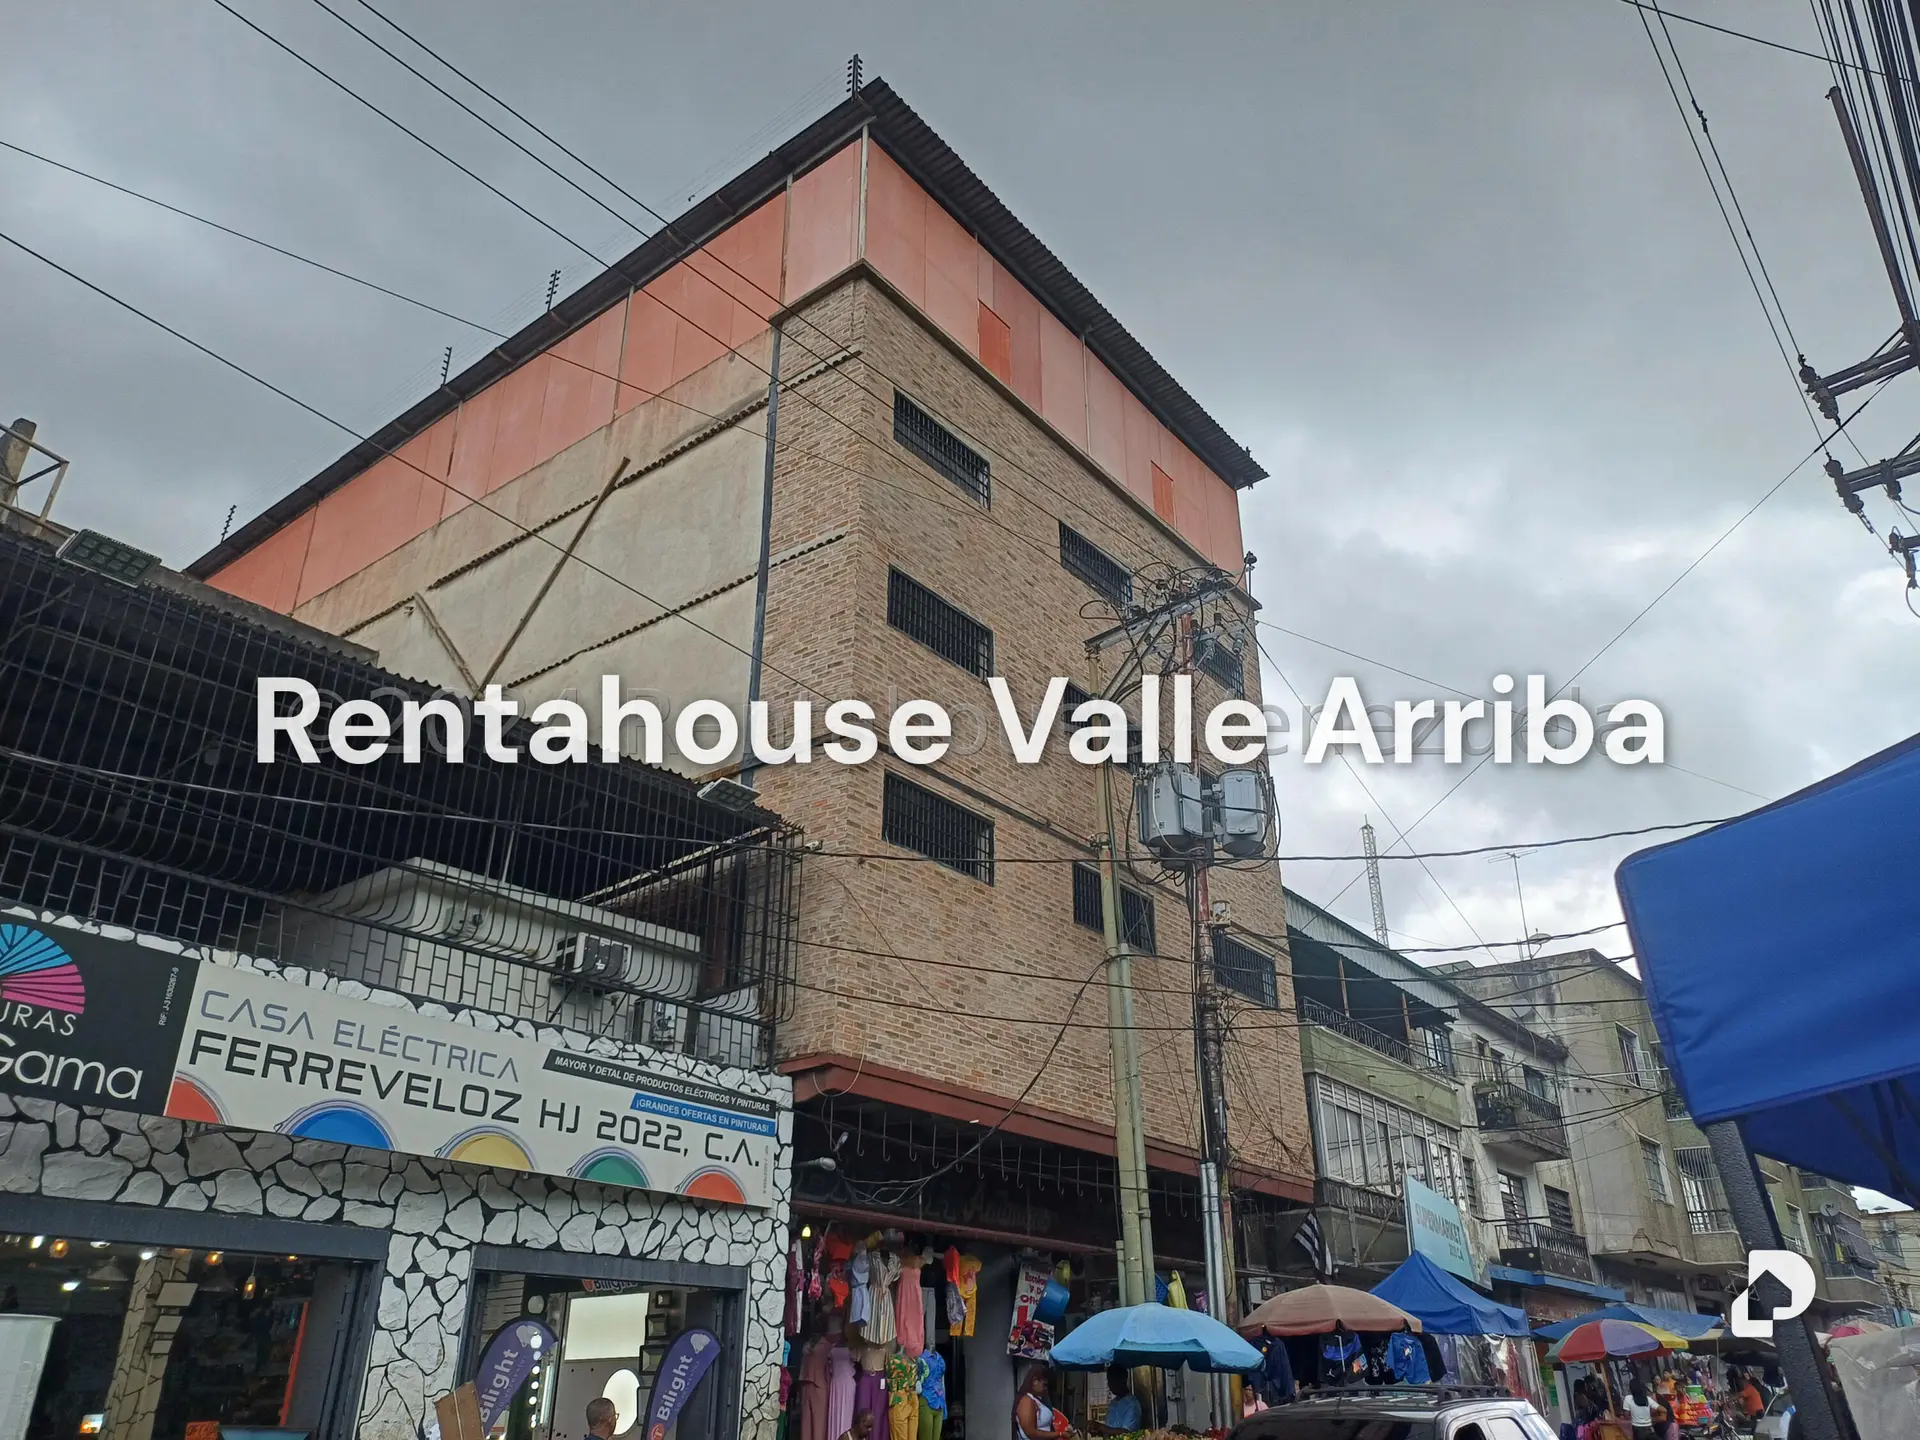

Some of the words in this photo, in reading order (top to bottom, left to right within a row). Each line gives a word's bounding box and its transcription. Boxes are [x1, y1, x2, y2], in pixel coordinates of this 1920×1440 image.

[201, 990, 314, 1040] CASA
[333, 1019, 519, 1083] ELÉCTRICA
[189, 1029, 522, 1124] FERREVELOZ
[539, 1098, 580, 1134] HJ
[597, 1110, 688, 1157] 2022,
[705, 1132, 759, 1167] C.A.
[554, 1056, 587, 1072] MAYOR
[588, 1064, 595, 1073] Y
[595, 1066, 622, 1079] DETAL
[622, 1072, 635, 1082] DE
[635, 1076, 684, 1093] PRODUCTOS
[684, 1086, 730, 1105] ELÉCTRICOS
[730, 1096, 737, 1105] Y
[736, 1099, 771, 1113] PINTURAS
[681, 1107, 717, 1123] OFERTAS
[718, 1115, 730, 1126] EN
[730, 1119, 769, 1133] PINTURAS!
[480, 1349, 520, 1423] Bilight
[656, 1355, 694, 1422] Bilight
